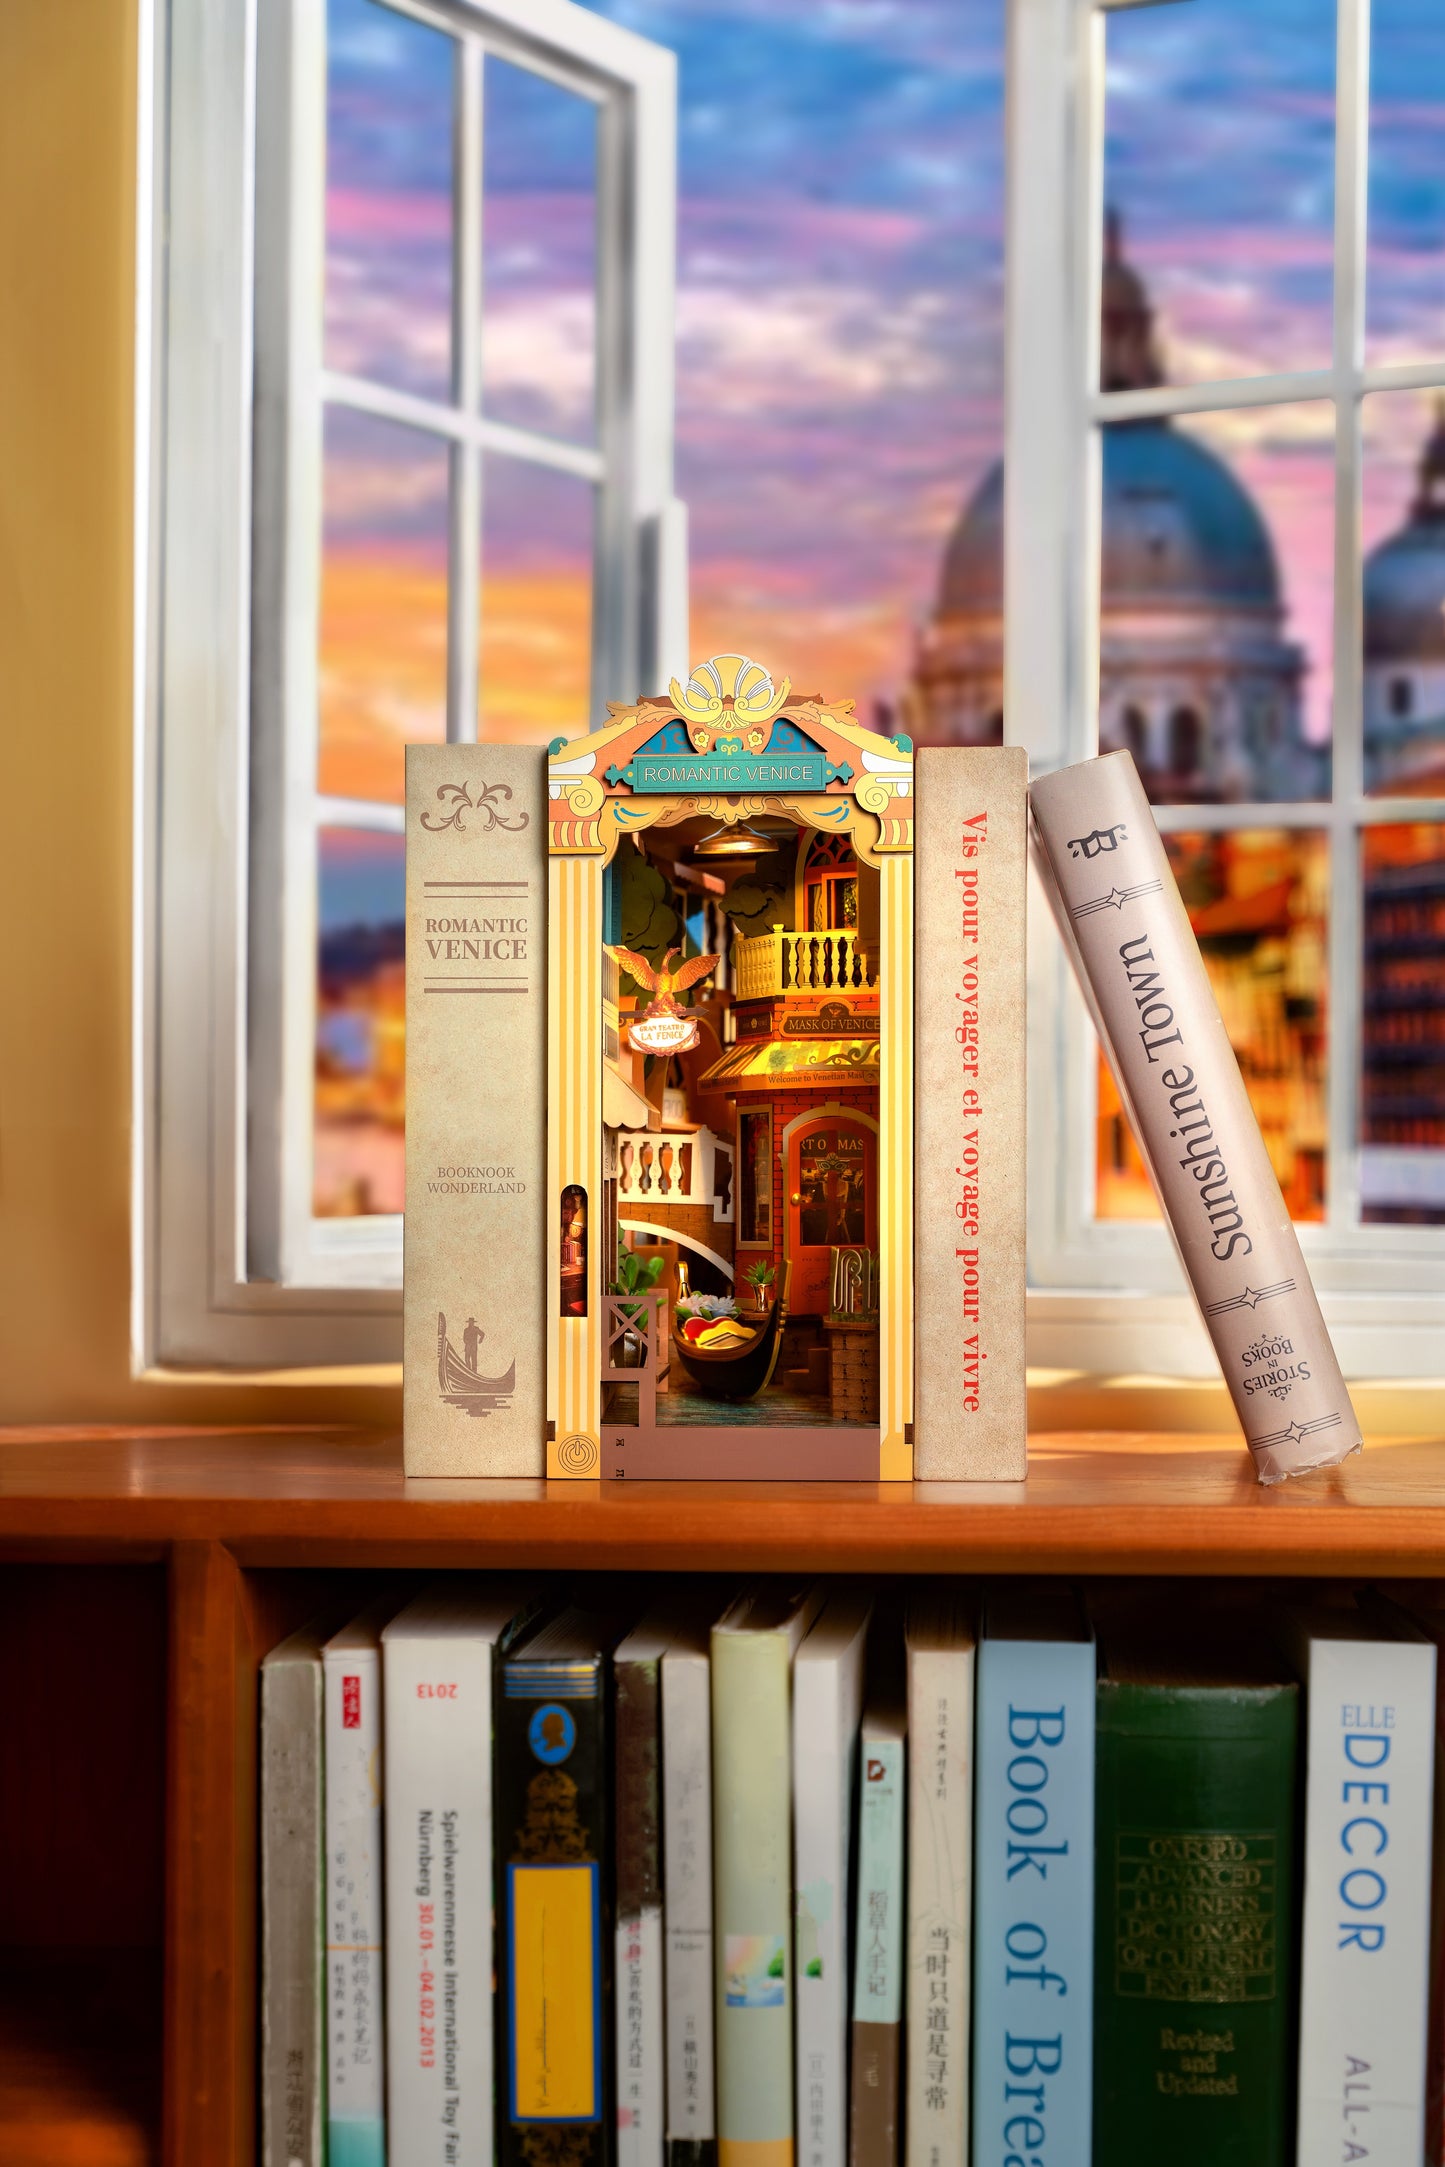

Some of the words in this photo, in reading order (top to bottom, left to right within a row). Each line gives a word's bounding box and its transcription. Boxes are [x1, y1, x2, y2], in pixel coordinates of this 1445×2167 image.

[644, 766, 740, 782] ROMANTIC
[745, 765, 814, 781] VENICE
[962, 810, 988, 858] Vis
[955, 868, 978, 943] pour
[425, 918, 528, 933] ROMANTIC
[425, 939, 528, 960] VENICE
[1119, 934, 1183, 1063] Town
[789, 1020, 817, 1030] MASK
[821, 1020, 834, 1030] OF
[839, 1019, 880, 1030] VENICE
[955, 954, 978, 1077] voyager
[641, 1032, 653, 1040] LA
[656, 1031, 684, 1040] FENICE
[768, 1075, 802, 1083] Welcome
[804, 1074, 811, 1082] to
[813, 1072, 845, 1081] Venetian
[963, 1089, 982, 1117] et
[437, 1166, 515, 1178] BOOKNOOK
[1161, 1065, 1253, 1261] Sunshine
[427, 1182, 526, 1194] WONDERLAND
[955, 1129, 979, 1236] voyage
[955, 1247, 979, 1323] pour
[1241, 1339, 1294, 1368] BOOKS
[1267, 1359, 1279, 1369] IN
[963, 1334, 987, 1412] vivre
[1243, 1361, 1311, 1396] STORIES
[416, 1683, 458, 1699] 2013
[1340, 1704, 1396, 1730] ELLE
[1006, 1704, 1069, 1882] Book
[414, 1809, 433, 1897] Nürnberg
[1150, 1838, 1248, 1861] OXFORD
[1338, 1734, 1392, 1954] DECOR
[440, 1810, 458, 1967] Spielwarenmesse
[1135, 1866, 1262, 1888] ADVANCED
[867, 1889, 888, 1997] 稻草人手记
[1128, 1918, 1267, 1942] DICTIONARY
[1004, 1922, 1067, 1997] of
[1156, 1946, 1274, 1970] CURRENT
[443, 1971, 461, 2091] International
[924, 1927, 951, 2111] 当时只道是寻常
[1160, 2028, 1235, 2051] Revised
[1180, 2053, 1218, 2074] and
[1156, 2072, 1239, 2097] Updated
[441, 2096, 460, 2127] Toy
[445, 2131, 460, 2167] Fair
